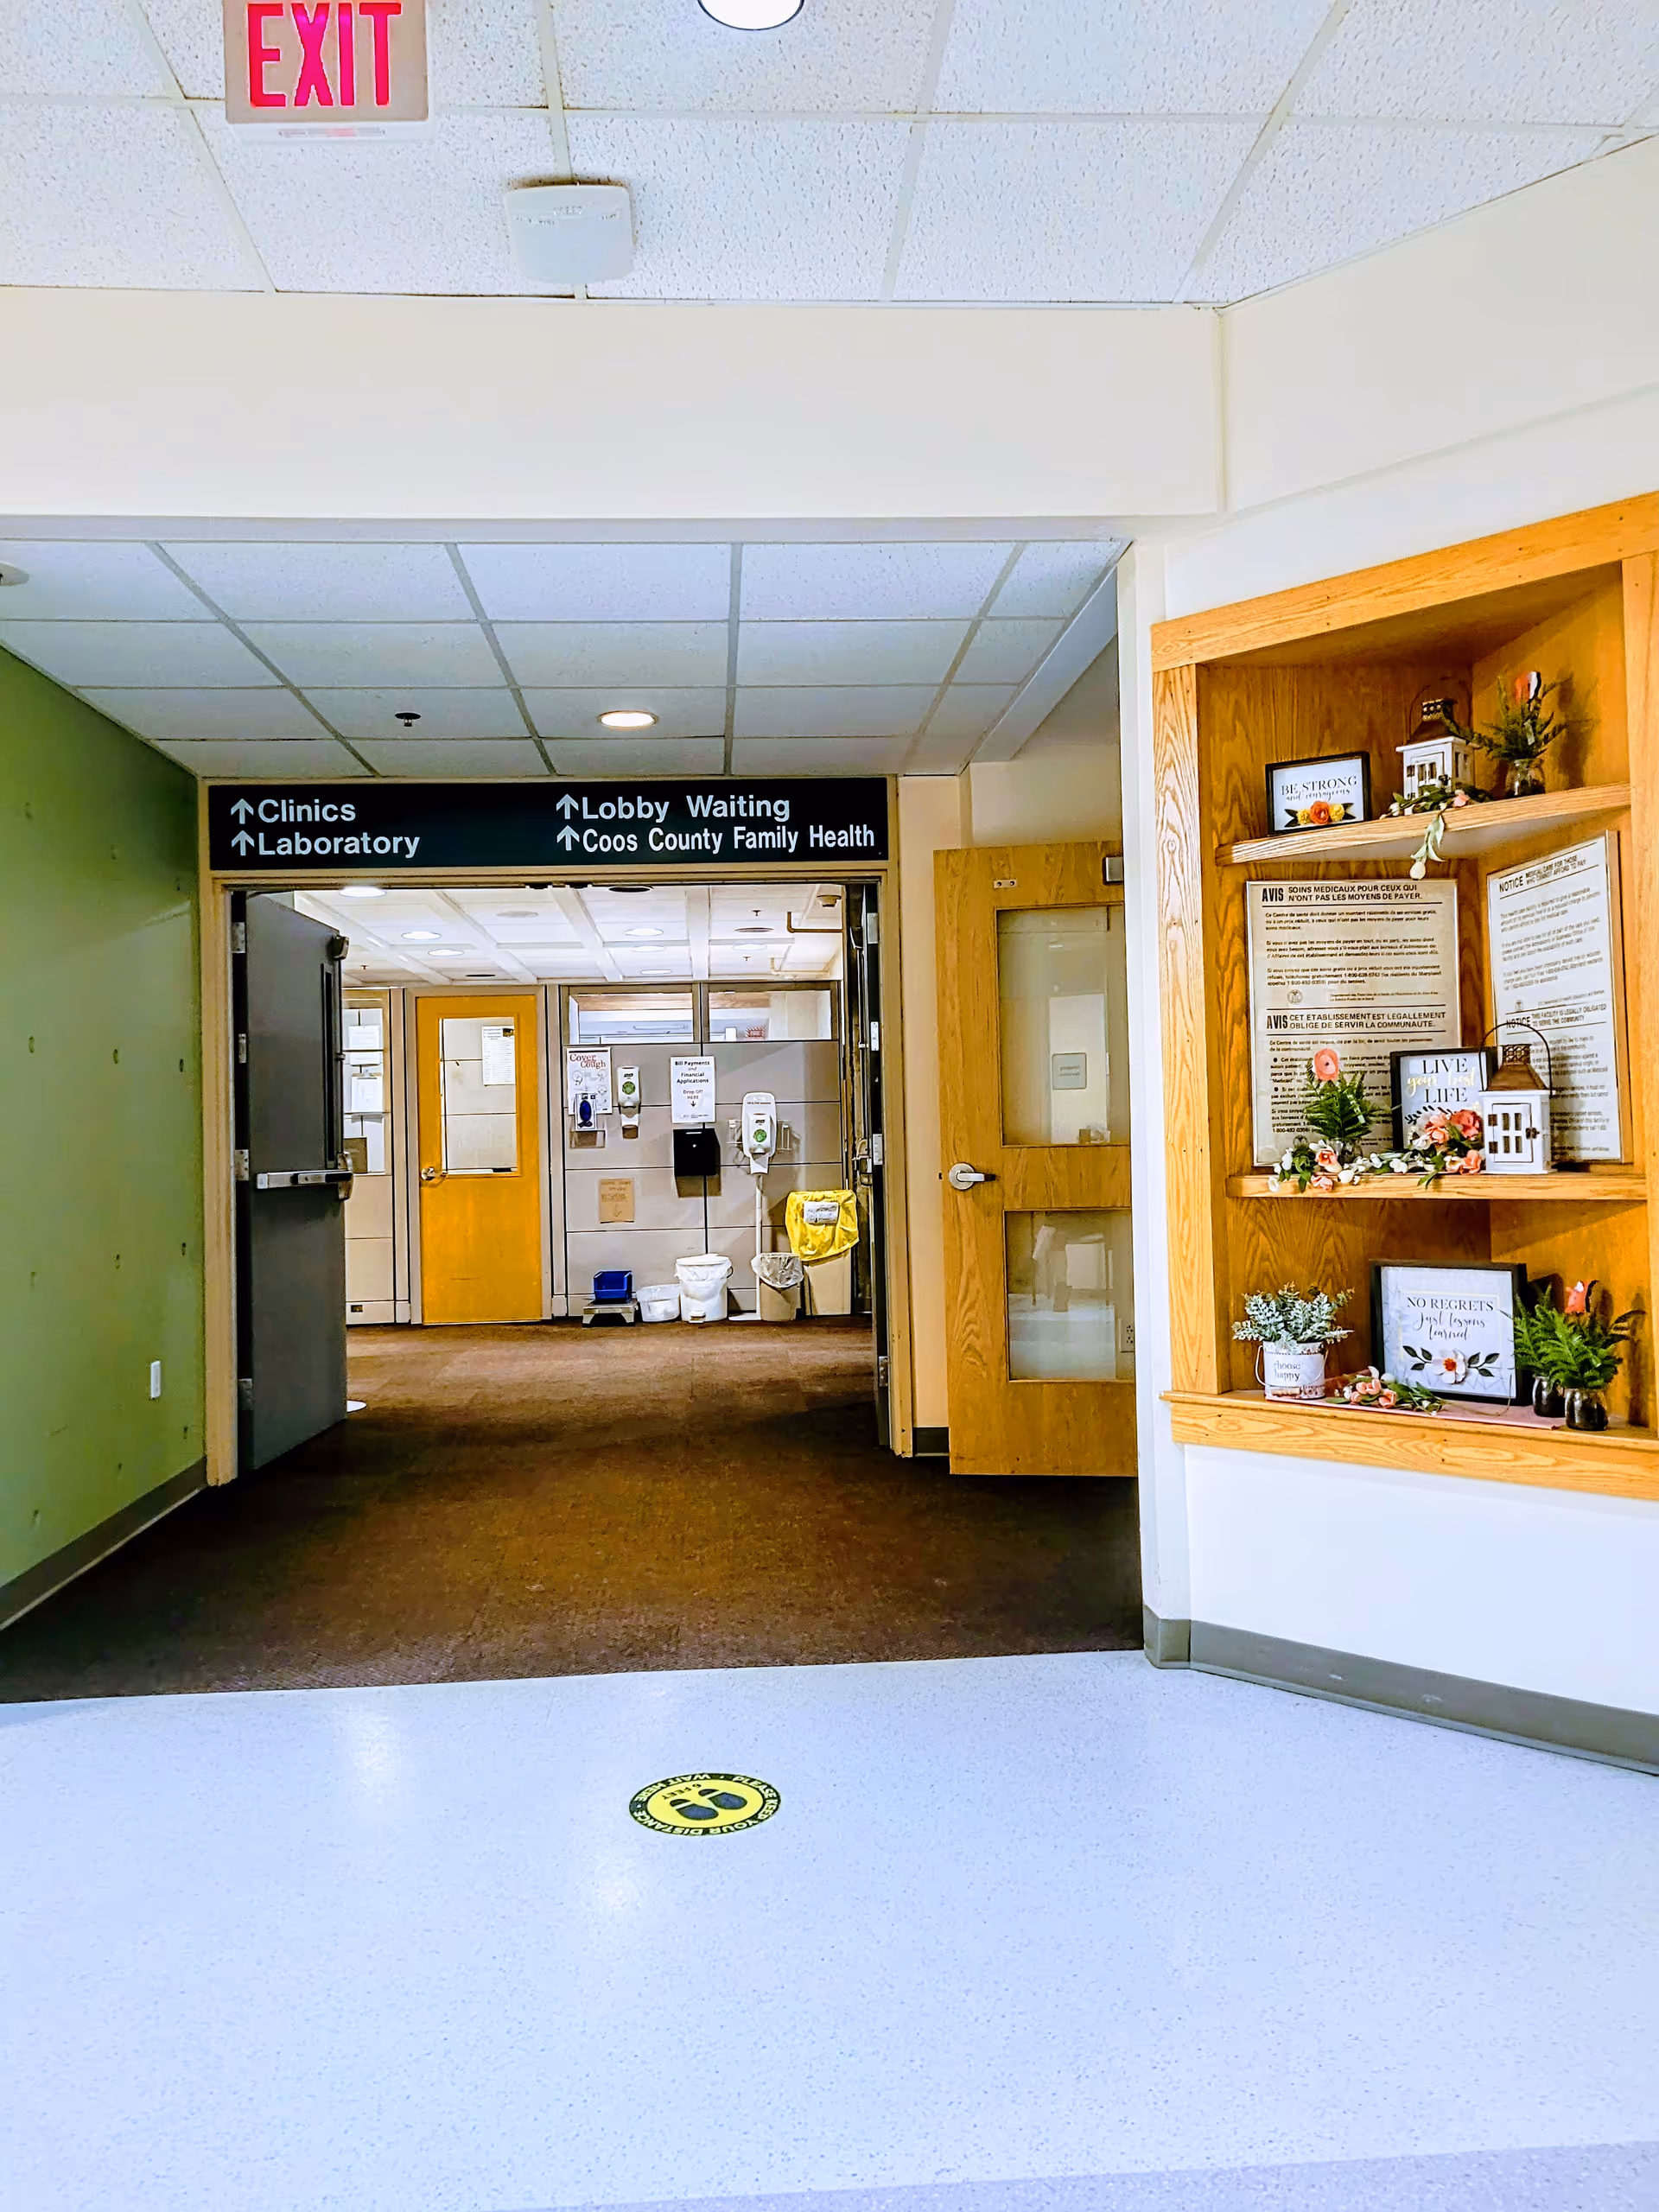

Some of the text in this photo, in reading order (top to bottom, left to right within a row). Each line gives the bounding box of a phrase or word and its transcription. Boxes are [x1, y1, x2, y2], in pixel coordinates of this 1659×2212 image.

[247, 3, 402, 107] EXIT
[1281, 775, 1357, 795] BE STRONG
[1286, 788, 1351, 802] and courageous
[258, 799, 356, 823] Clinics
[582, 794, 790, 823] Lobby Waiting
[258, 831, 420, 859] Laboratory
[582, 823, 875, 855] Coos County Family Health
[1542, 864, 1554, 873] CARE
[1563, 855, 1578, 864] THOSE
[1553, 865, 1569, 875] AFFORD
[1499, 875, 1523, 893] NOTICE
[1262, 888, 1284, 902] AVIS
[1583, 1003, 1607, 1013] OBLIGATED
[1267, 1014, 1287, 1029] AVIS
[1506, 1016, 1530, 1028] NOTICE
[569, 1053, 596, 1062] Cover
[581, 1060, 607, 1070] Cough
[1422, 1058, 1468, 1074] LIVE
[1406, 1075, 1438, 1098] your
[1447, 1065, 1477, 1087] best
[1425, 1087, 1468, 1103] LIFE
[1407, 1297, 1494, 1312] NO REGRETS
[1413, 1310, 1486, 1331] Just lessons
[1429, 1328, 1471, 1341] learned
[1273, 1359, 1302, 1370] choose
[1274, 1370, 1300, 1382] happy
[633, 1773, 711, 1802] WAIT HERE
[662, 1787, 692, 1800] FEET
[633, 1776, 779, 1835] PLEASE KEEP YOUR DISTANCE
